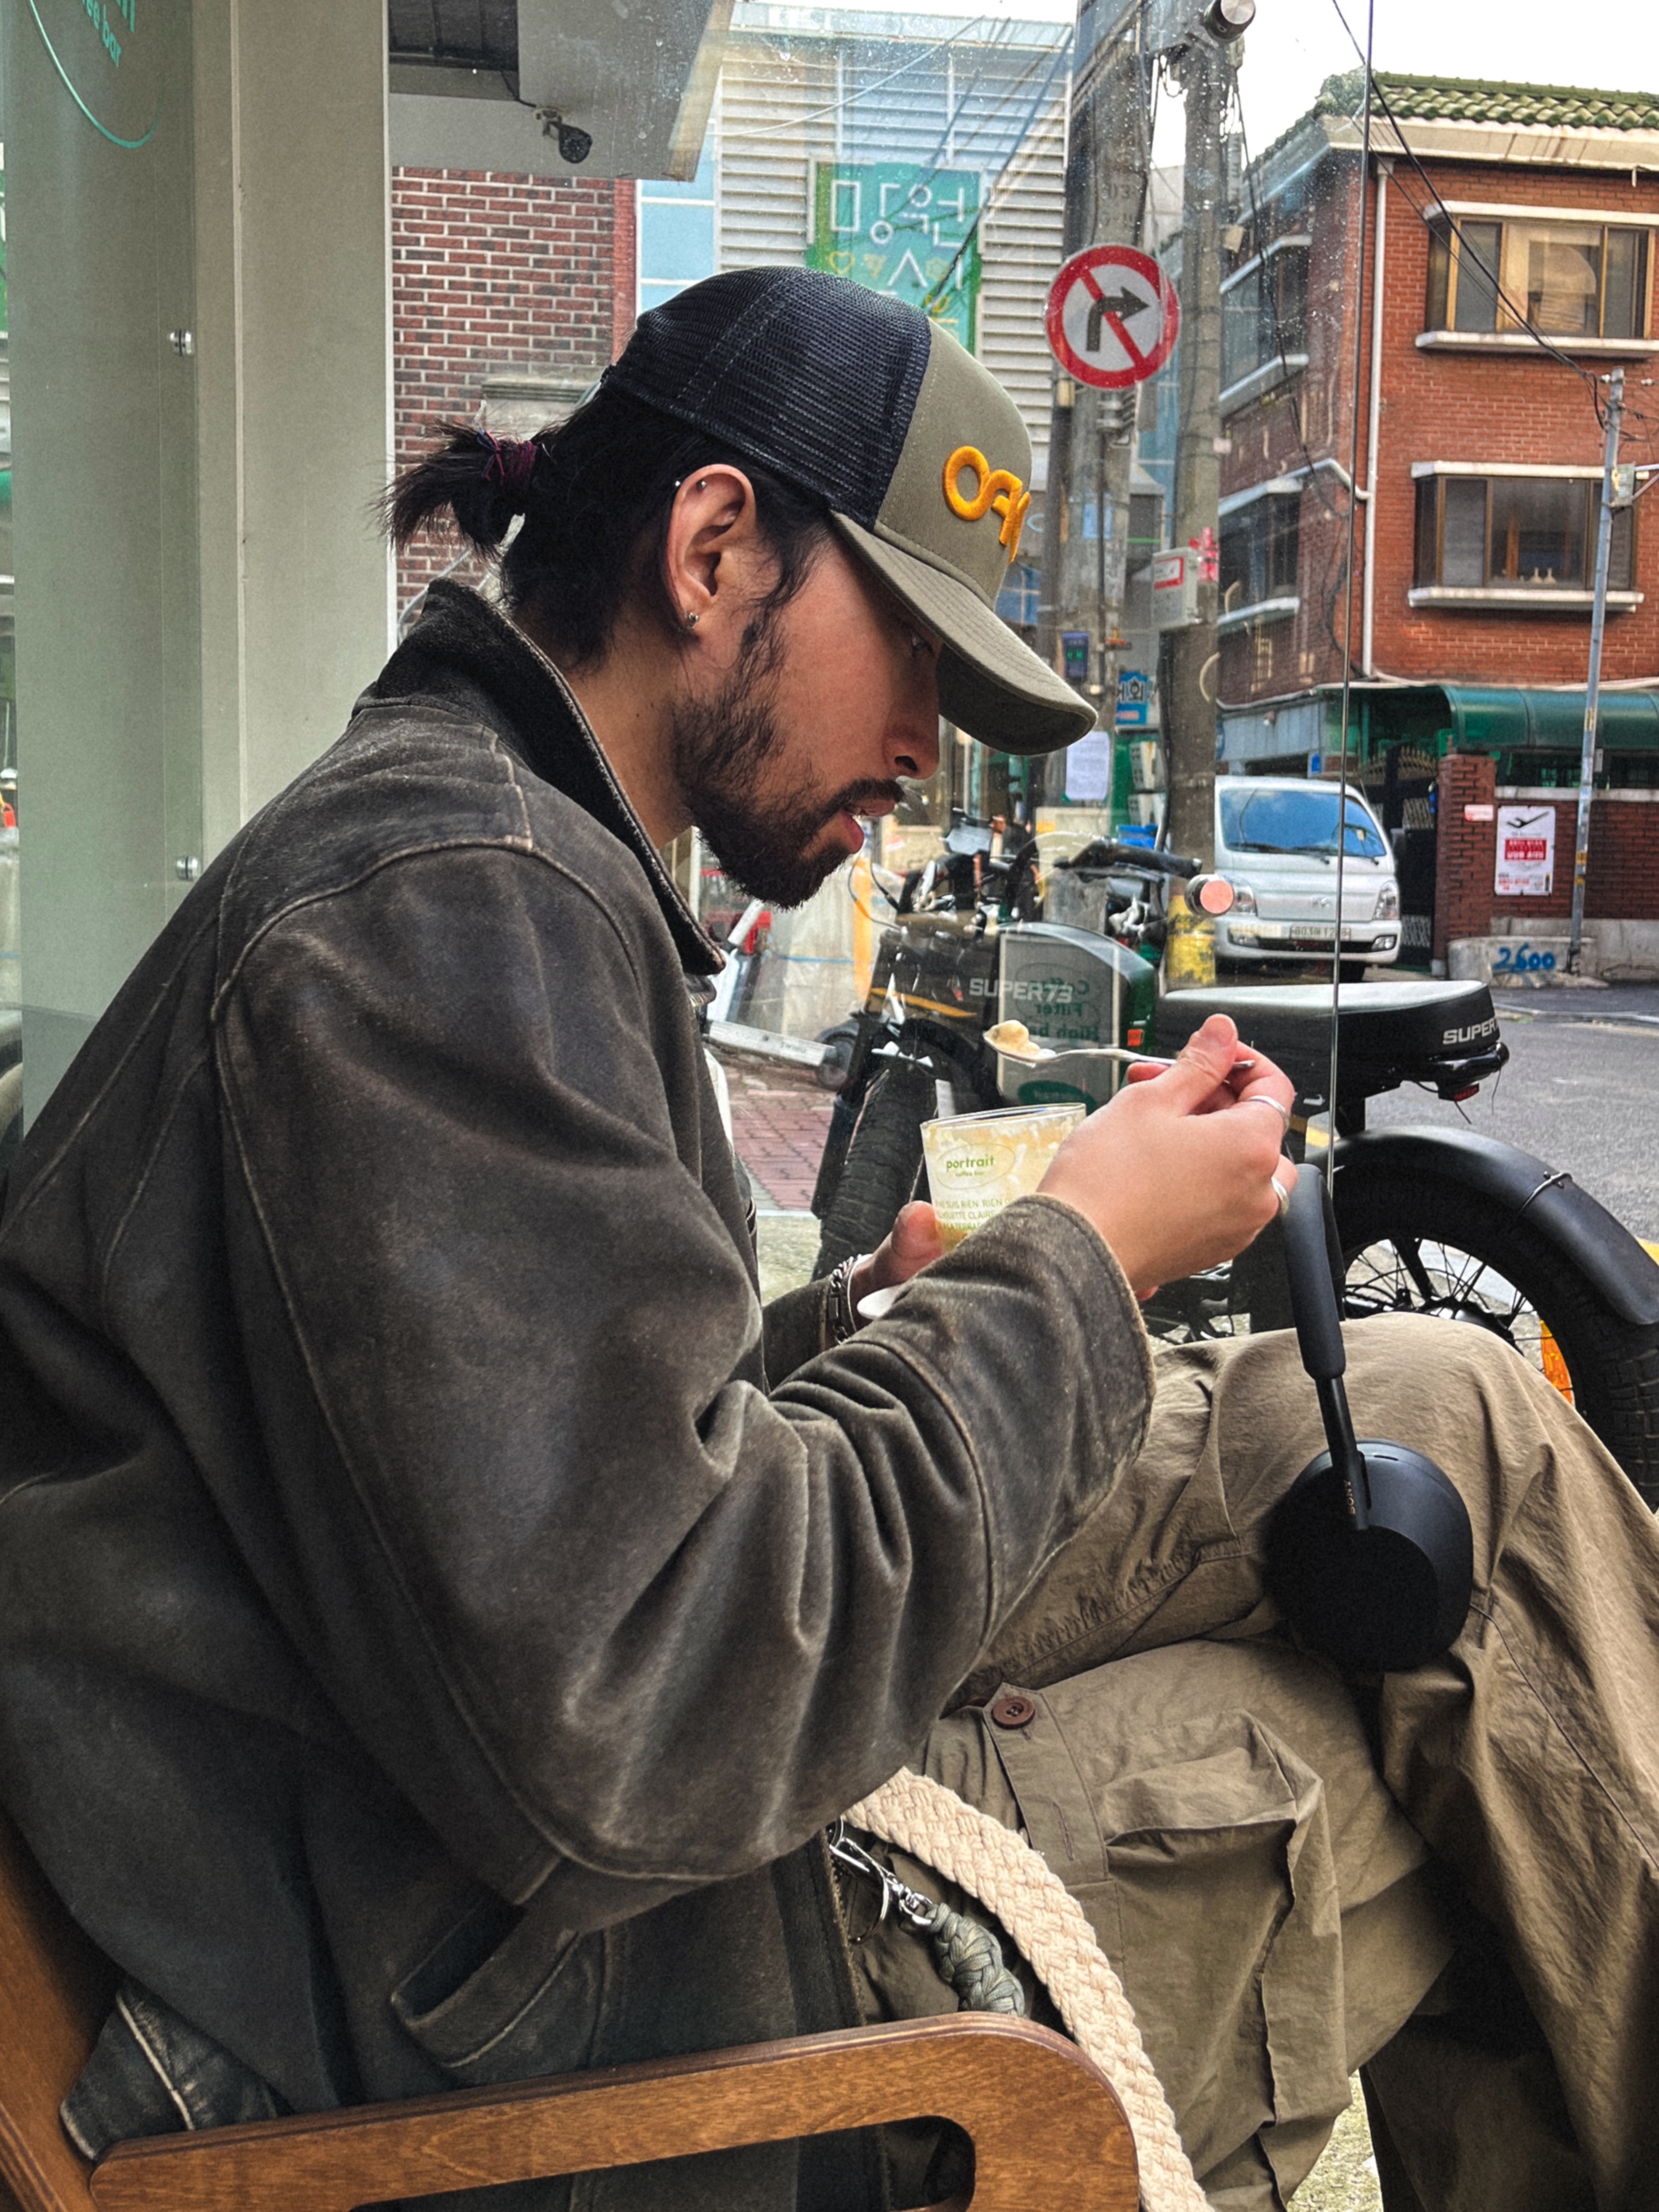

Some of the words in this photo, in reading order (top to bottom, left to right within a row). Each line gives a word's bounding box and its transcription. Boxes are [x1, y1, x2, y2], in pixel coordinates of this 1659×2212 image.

[103, 4, 121, 67] bar
[1493, 943, 1556, 972] 2600
[969, 978, 1073, 1003] SUPER73
[946, 1154, 995, 1172] portrait
[955, 1222, 981, 1231] TERRAS
[1344, 1480, 1356, 1514] SONY
